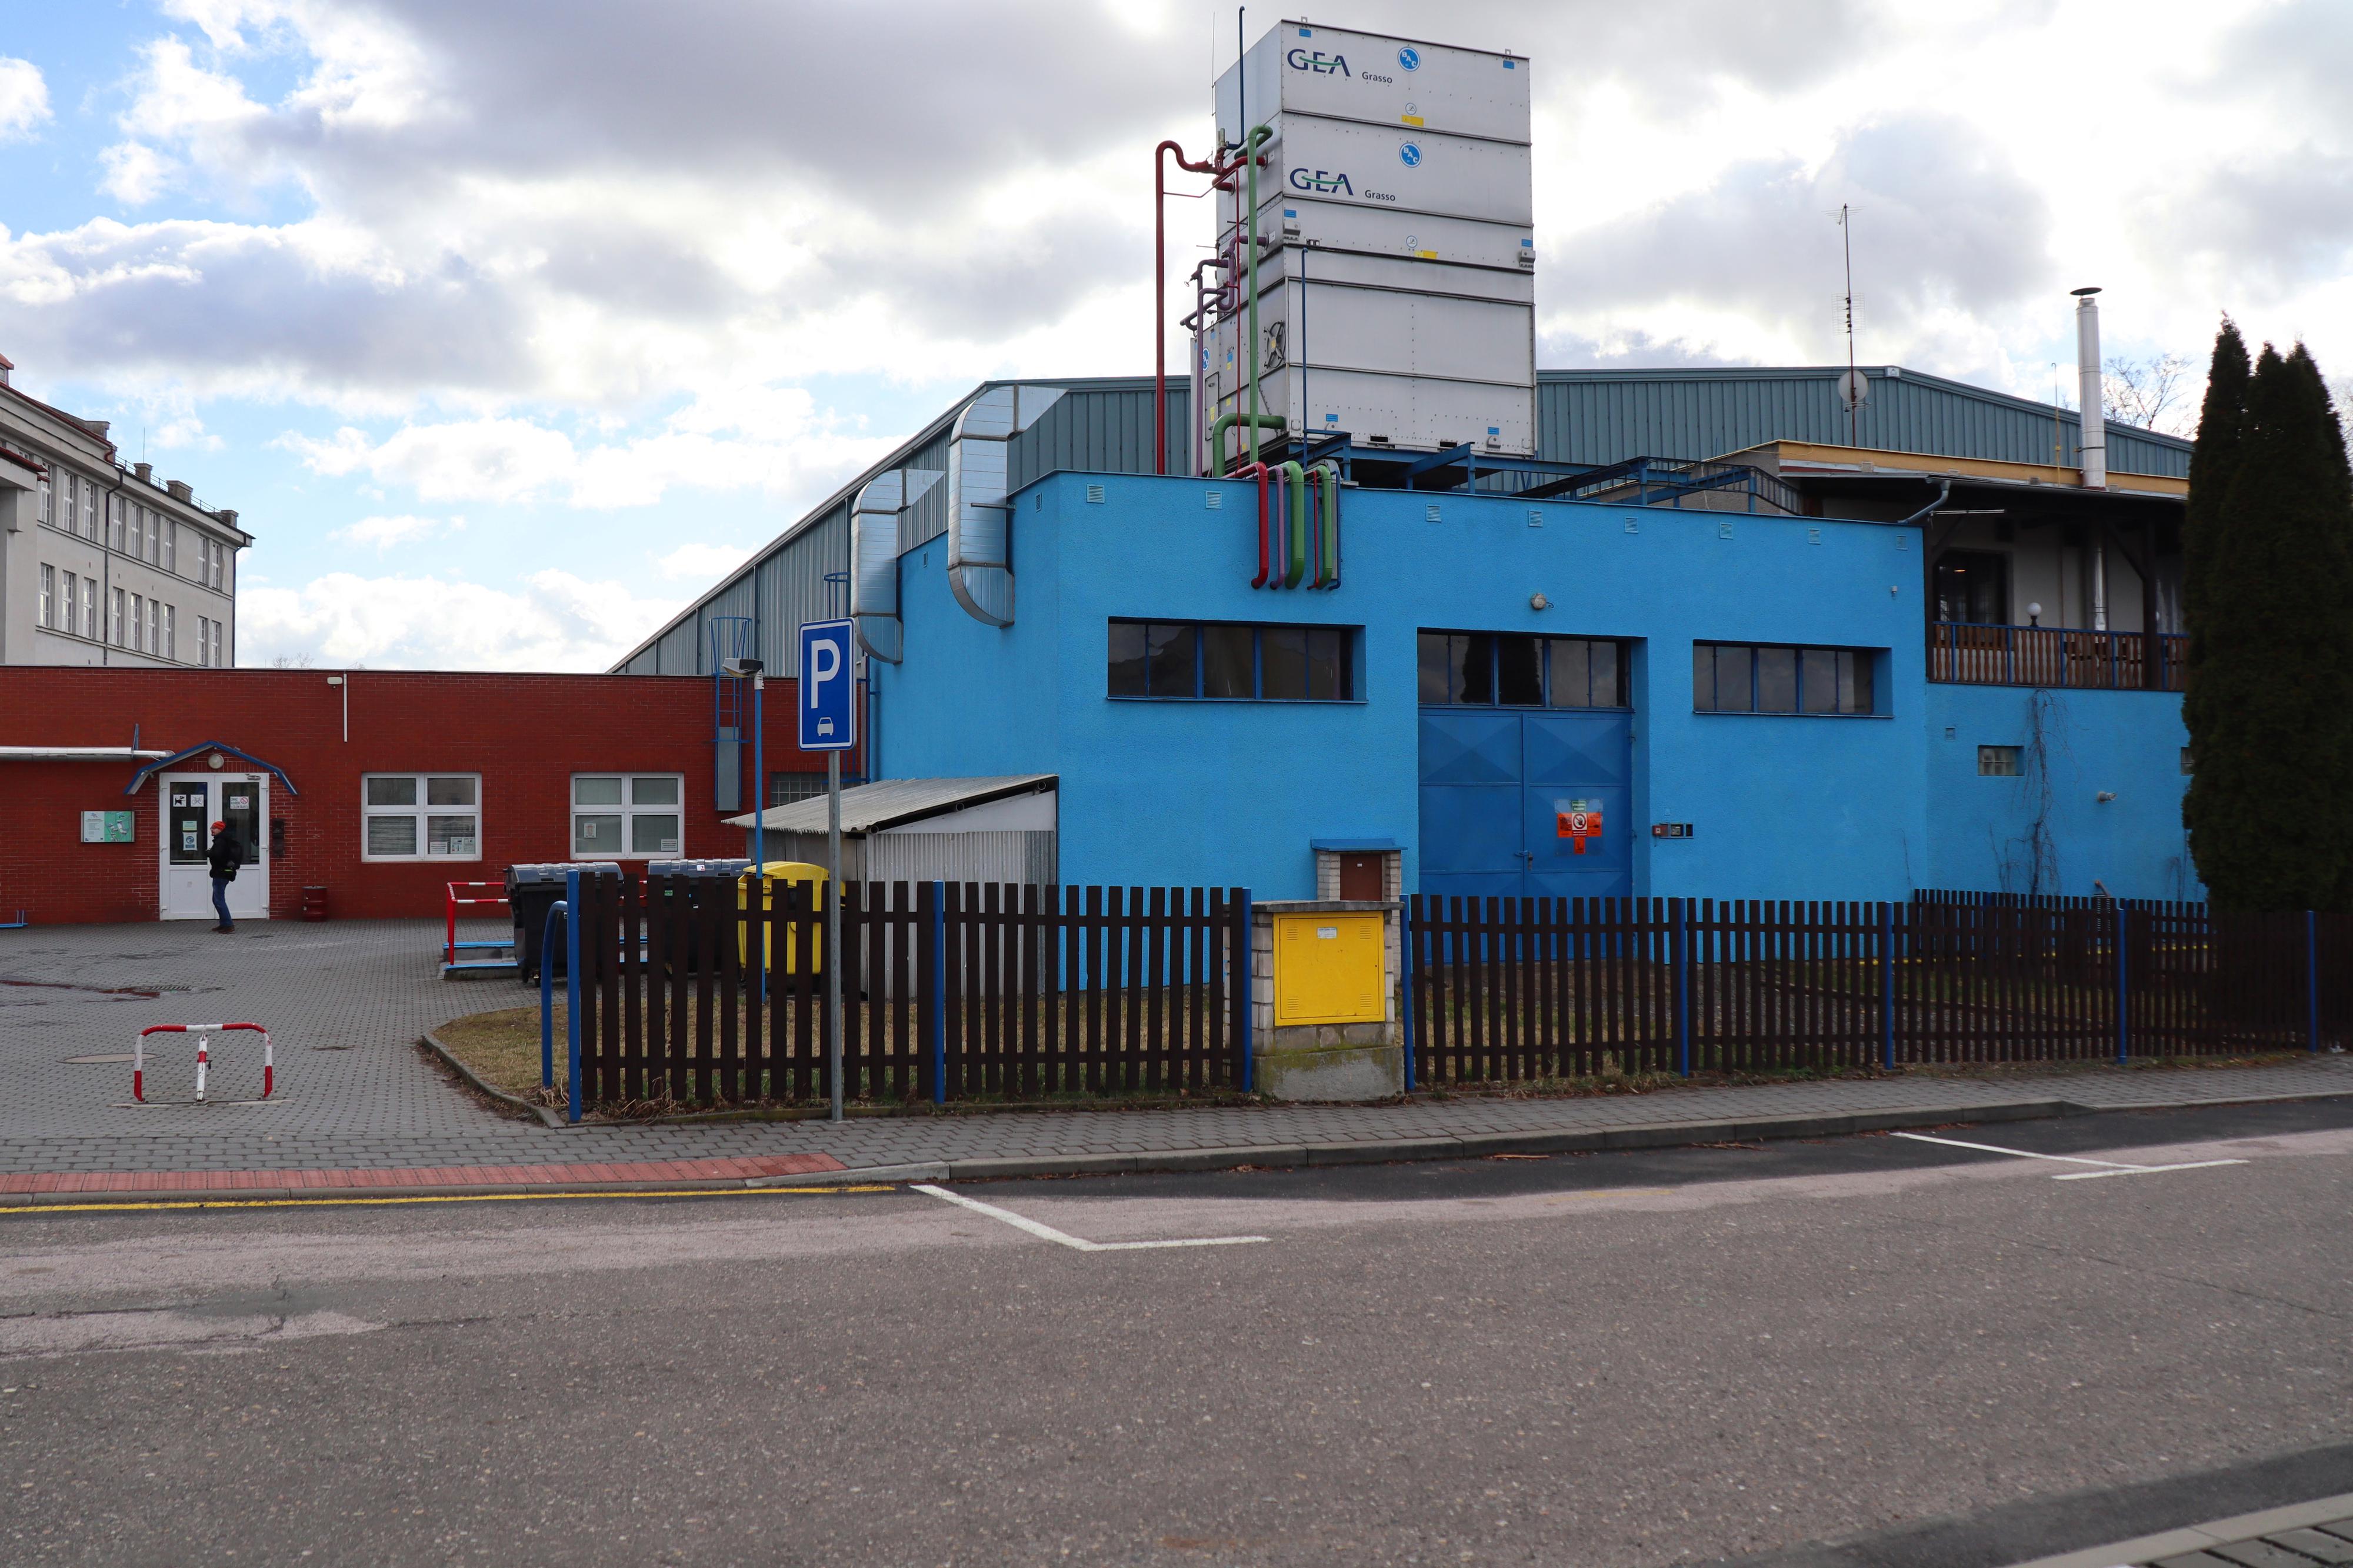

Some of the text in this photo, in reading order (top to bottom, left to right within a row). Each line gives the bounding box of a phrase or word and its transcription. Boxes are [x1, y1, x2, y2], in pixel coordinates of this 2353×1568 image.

[1287, 48, 1392, 84] GEA Grasso
[1402, 51, 1417, 67] BAC
[1404, 147, 1418, 163] BAC
[1289, 168, 1395, 201] GEA Grasso
[811, 639, 841, 709] P
